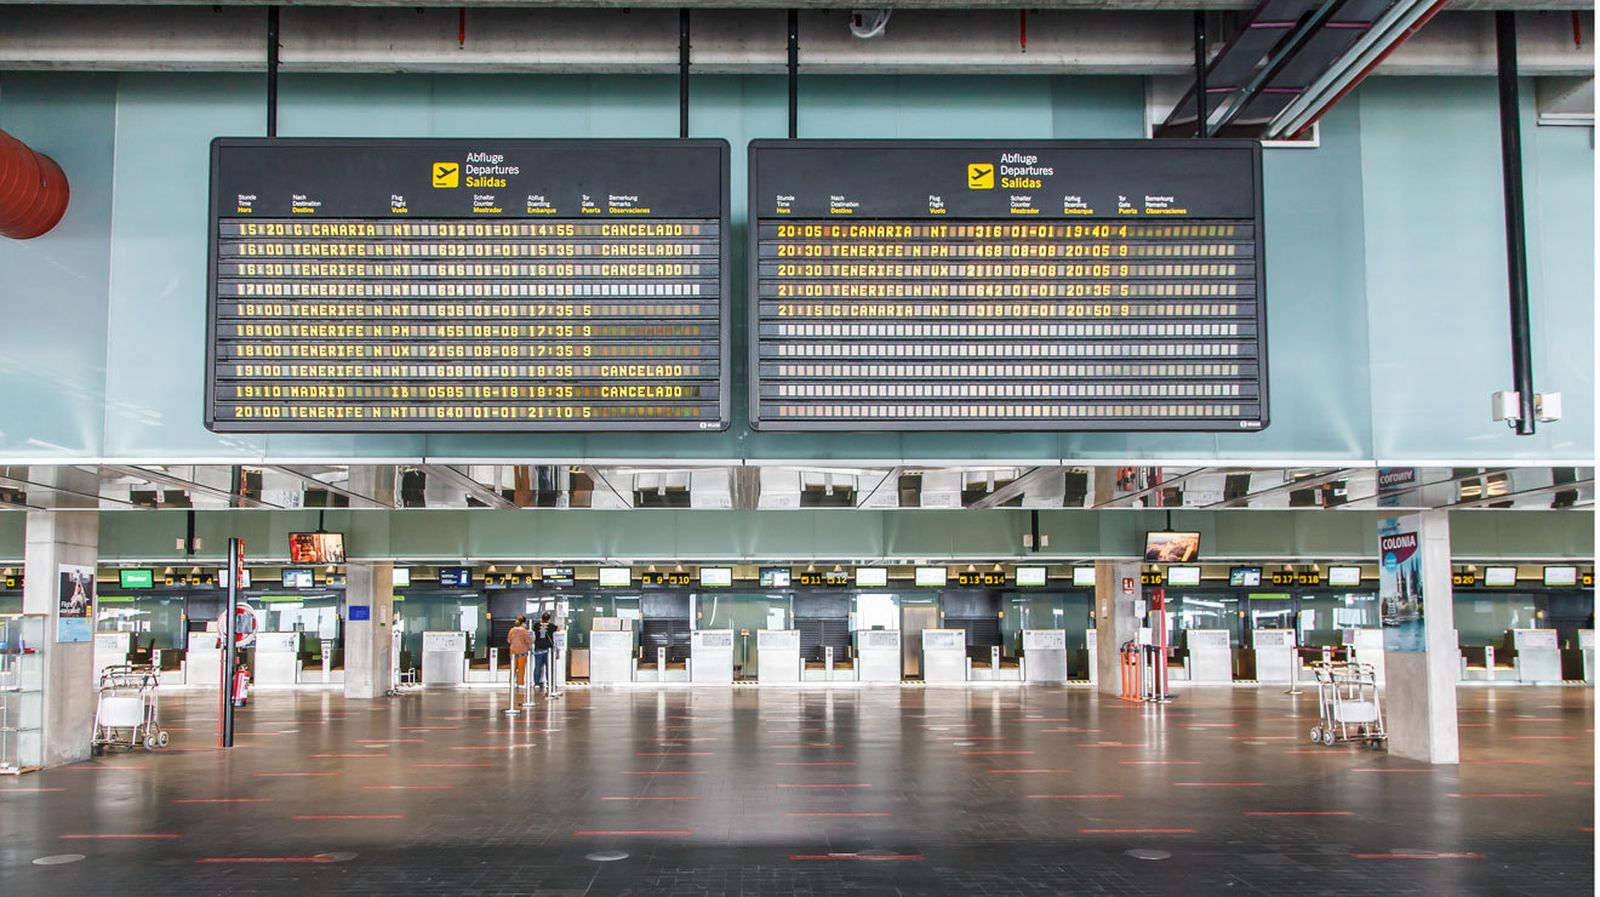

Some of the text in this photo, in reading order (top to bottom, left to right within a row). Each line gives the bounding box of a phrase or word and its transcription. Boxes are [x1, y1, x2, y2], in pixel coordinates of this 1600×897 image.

[466, 153, 503, 164] Abfluge
[1001, 154, 1037, 165] Abfluge
[465, 164, 519, 176] Departures
[1001, 165, 1053, 177] Departures
[466, 177, 506, 188] Salidas
[1001, 178, 1041, 188] Salidas
[239, 224, 680, 236] 15:20 G.CANARIA NT 312 01-01 14:55 CANCELADO
[778, 226, 1127, 237] 20:05 G.CANARIA NT 316 01-01 19:40 4
[238, 245, 680, 256] 16:00 TENERIFE N NT 632 01-01 15:35 CANCELADO
[778, 246, 1127, 257] 20:30 TENERIFE N PM 468 08-08 20:05 9
[238, 265, 282, 276] 16:30
[293, 265, 364, 276] TENERIFE
[374, 265, 382, 276] N
[392, 265, 409, 276] NT
[474, 265, 518, 276] 01-01
[529, 265, 572, 276] 16:05
[601, 265, 680, 276] CANCELADO
[778, 266, 1128, 277] 20:30 TENERIFE N UX 2110 08-08 20:05 9
[292, 285, 363, 296] TENERIFE
[778, 285, 1128, 296] 21:00 TENERIFE N NT 642 01-01 20:35 5
[237, 305, 282, 316] 18:00
[292, 305, 363, 316] TENERIFE
[374, 305, 382, 316] N
[392, 305, 409, 316] NT
[474, 305, 518, 316] 01-01
[528, 305, 572, 316] 17:35
[583, 305, 590, 316] 5
[778, 305, 822, 316] 21:15
[932, 305, 949, 316] NT
[1013, 305, 1057, 316] 01-01
[1067, 305, 1111, 316] 20:50
[1122, 305, 1128, 316] 9
[237, 326, 590, 337] 18:00 TENERIFE N PM 455 08-08 17:35 9
[237, 346, 590, 357] 18:00 TENERIFE N UX 2156 08-08 17:35 9
[236, 366, 681, 377] 19:00 TENERIFE N NT 638 01-01 18:35 CANCELADO
[236, 386, 681, 397] 19:10 MADRID IB 0585 16-18 18:35 CANCELADO
[236, 406, 590, 418] 20:00 TENERIFE N NT 640 01-01 21:10 5
[1382, 535, 1416, 550] COLONIA
[500, 577, 506, 585] 7
[525, 577, 532, 585] 8
[657, 576, 663, 585] 9
[679, 576, 690, 585] 10
[810, 576, 821, 584] 11
[836, 576, 847, 584] 12
[969, 576, 980, 584] 13
[994, 576, 1005, 584] 14
[1150, 575, 1161, 584] 16
[1282, 575, 1293, 584] 17
[1308, 575, 1319, 584] 18
[1462, 576, 1474, 584] 20
